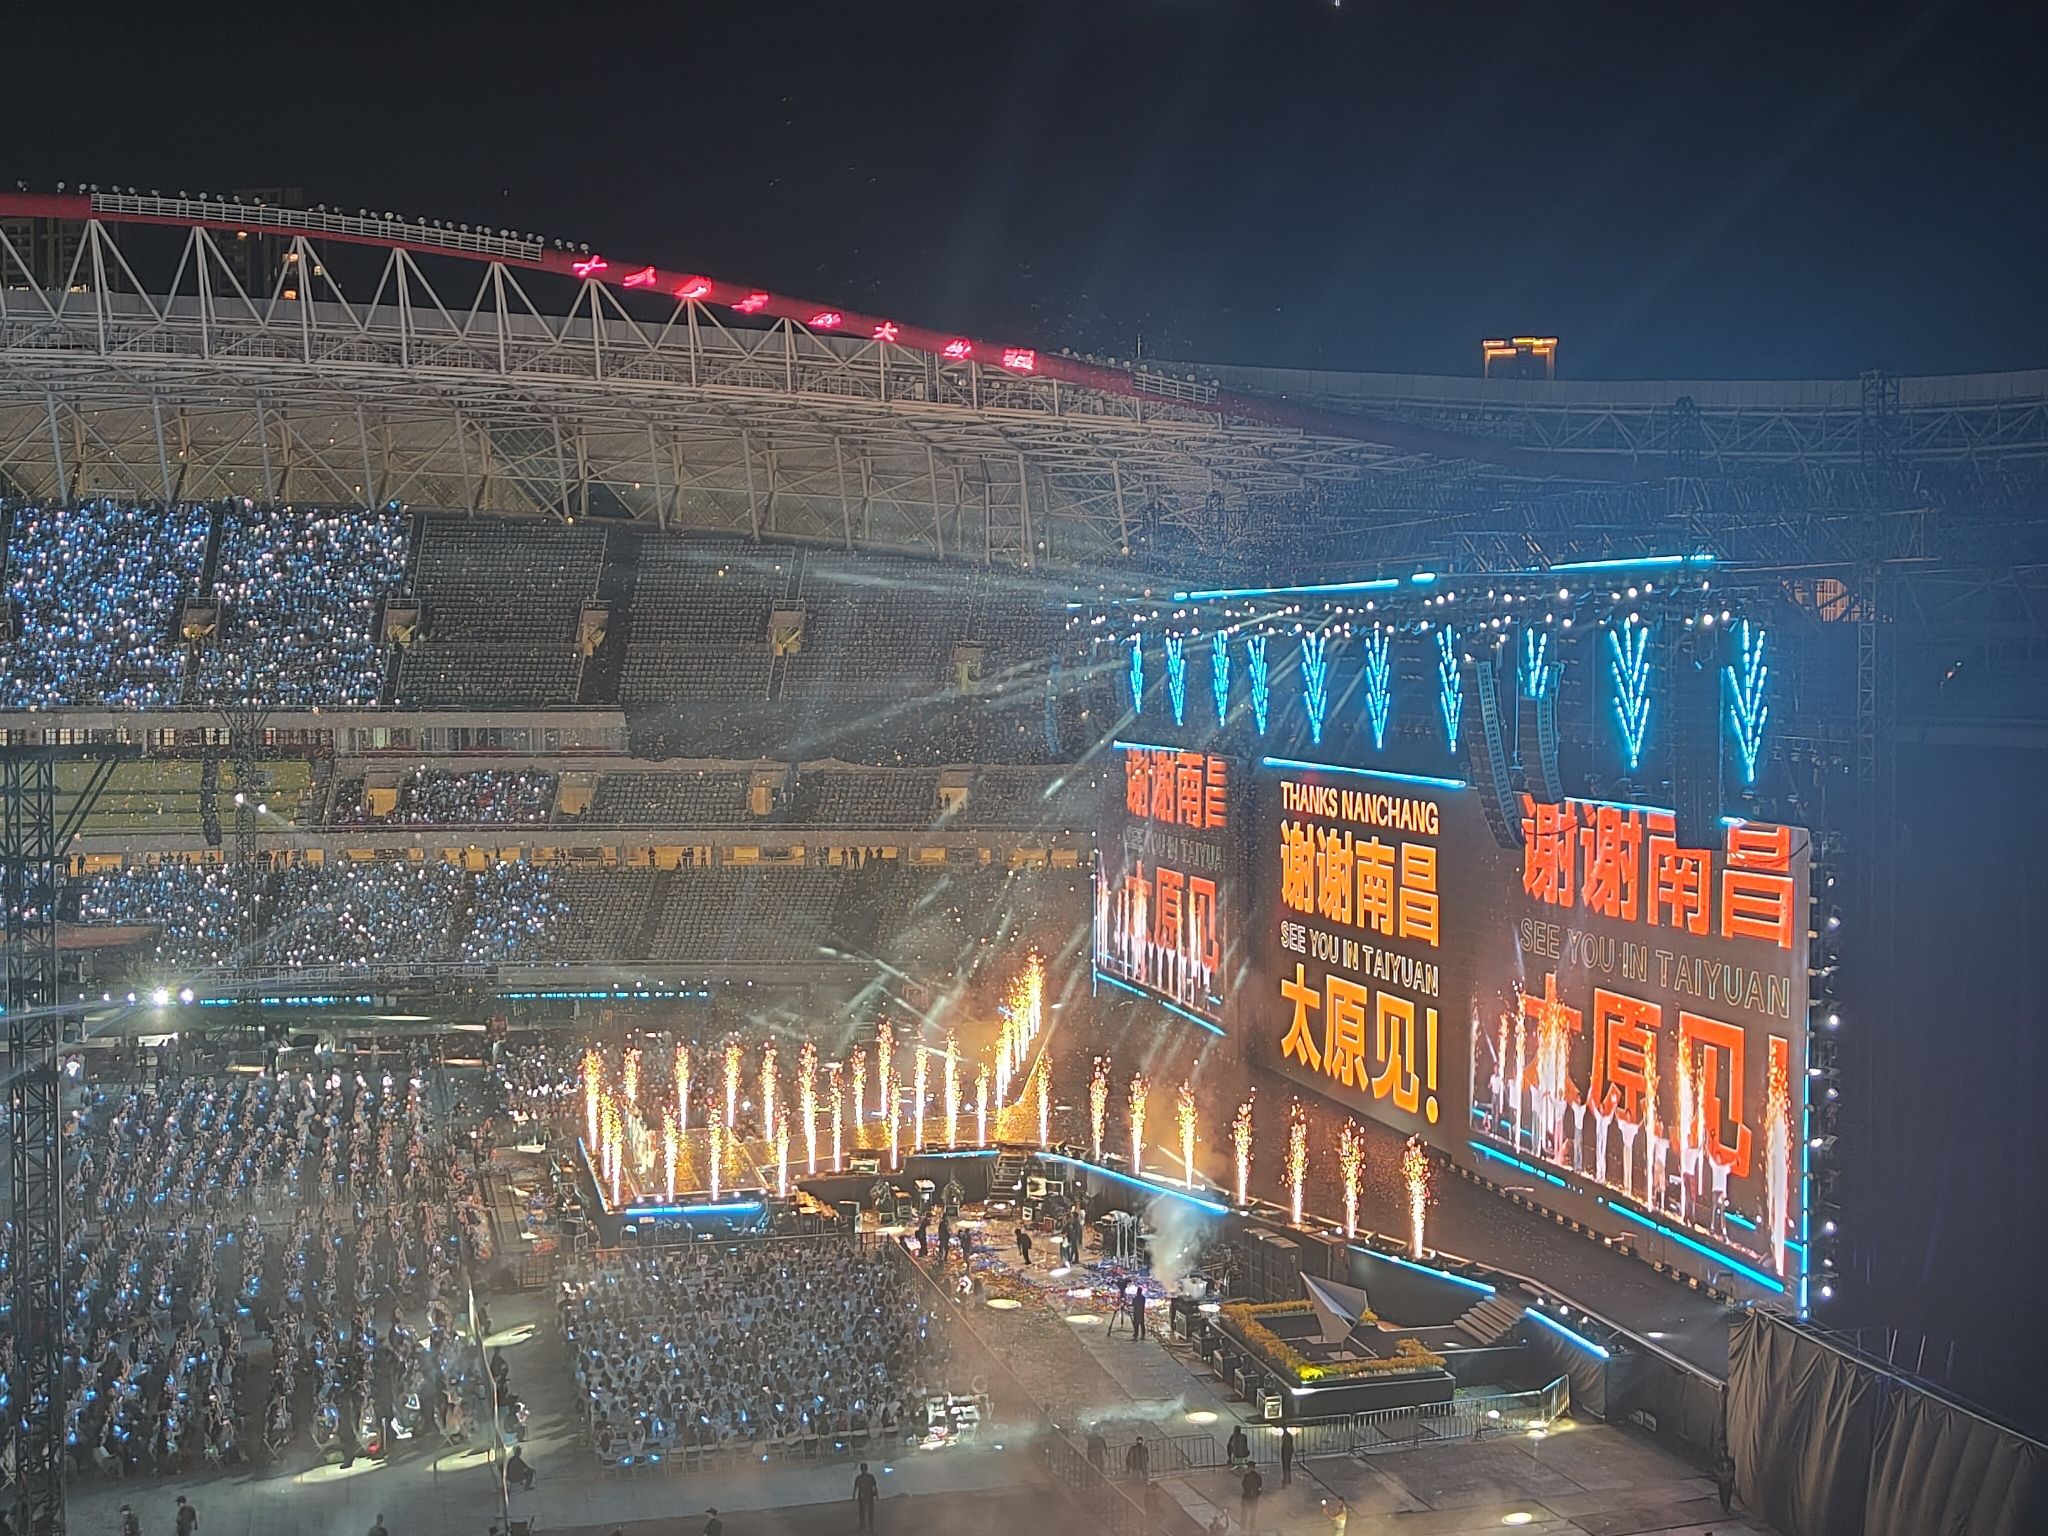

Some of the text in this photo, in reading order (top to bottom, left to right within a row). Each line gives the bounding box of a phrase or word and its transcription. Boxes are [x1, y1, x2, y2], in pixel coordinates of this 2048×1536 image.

[1126, 748, 1227, 828] 谢谢南昌
[1280, 781, 1440, 835] THANKS NANCHANG
[1280, 819, 1440, 948] 谢谢南昌
[1522, 792, 1794, 949] 谢谢南昌
[1280, 920, 1439, 998] SEE YOU IN TAIYUAN
[1520, 917, 1791, 1019] SEE YOU IN TAIYUAN
